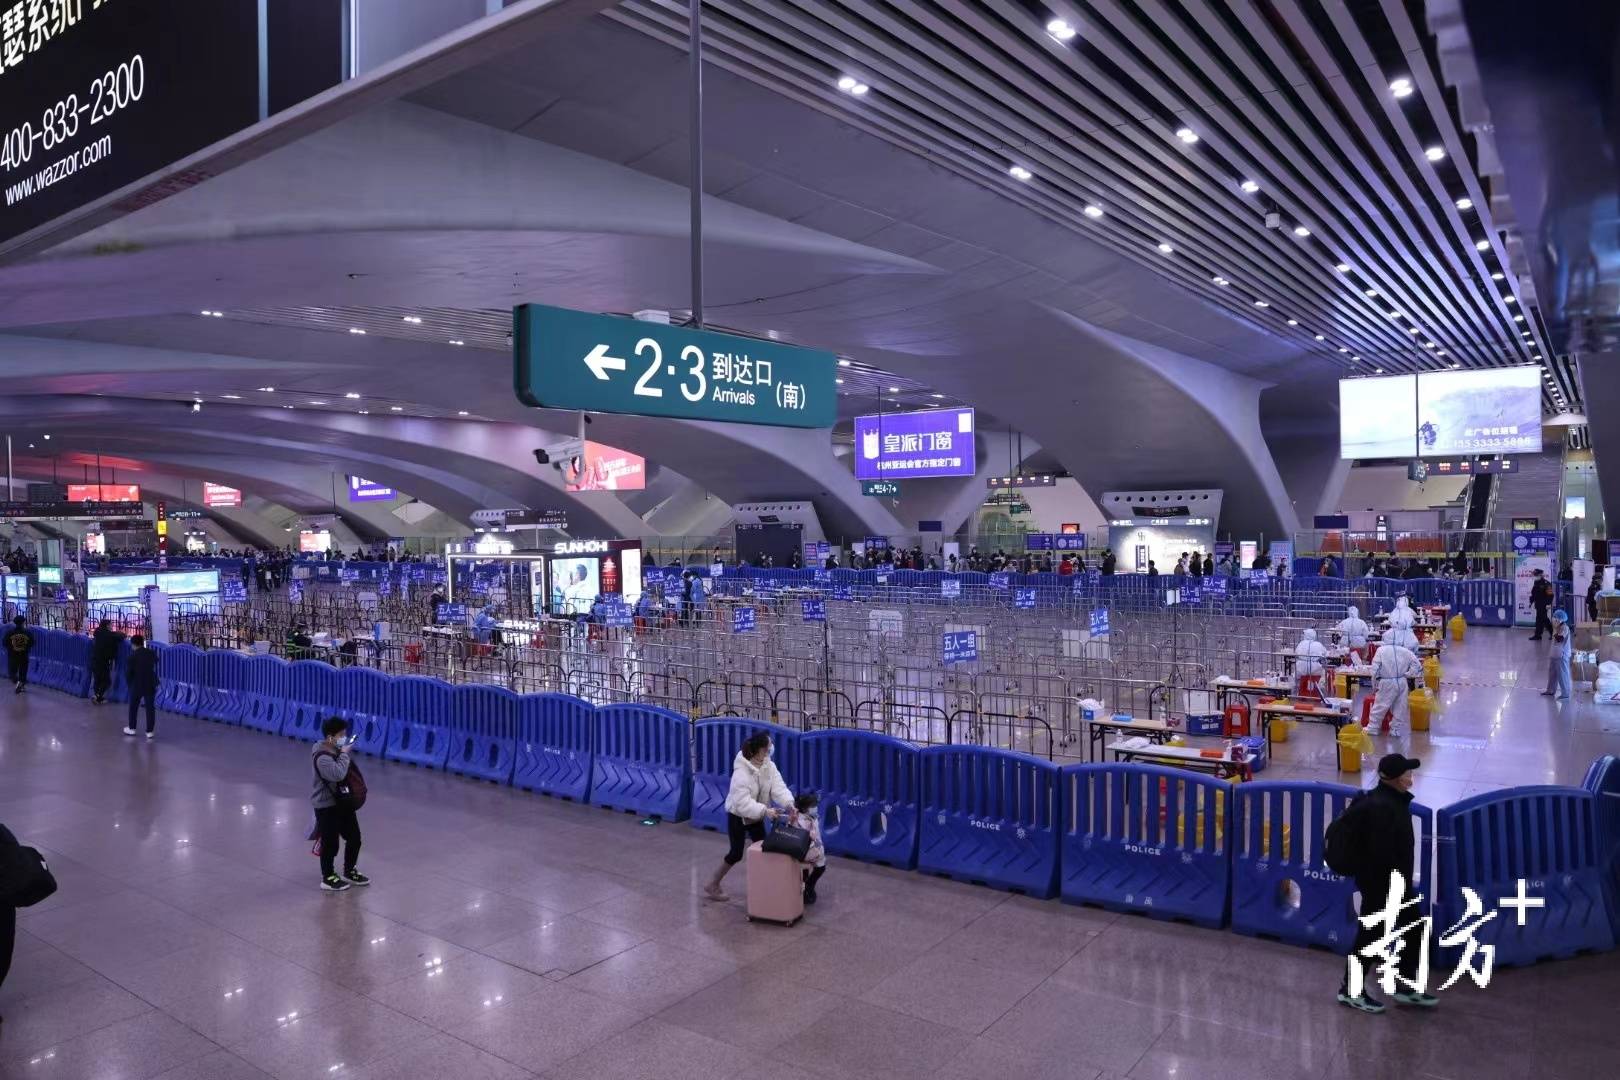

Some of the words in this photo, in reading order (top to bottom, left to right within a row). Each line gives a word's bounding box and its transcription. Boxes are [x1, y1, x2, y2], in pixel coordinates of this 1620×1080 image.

[0, 54, 144, 172] 400-833-2300
[5, 135, 111, 206] www.wazzor.com
[712, 352, 772, 386] 到达口
[712, 389, 755, 406] Arrivals
[884, 431, 952, 453] 皇派门窗
[944, 633, 975, 650] 五人一组
[970, 820, 1001, 831] POLICE
[1124, 844, 1161, 856] POLICE
